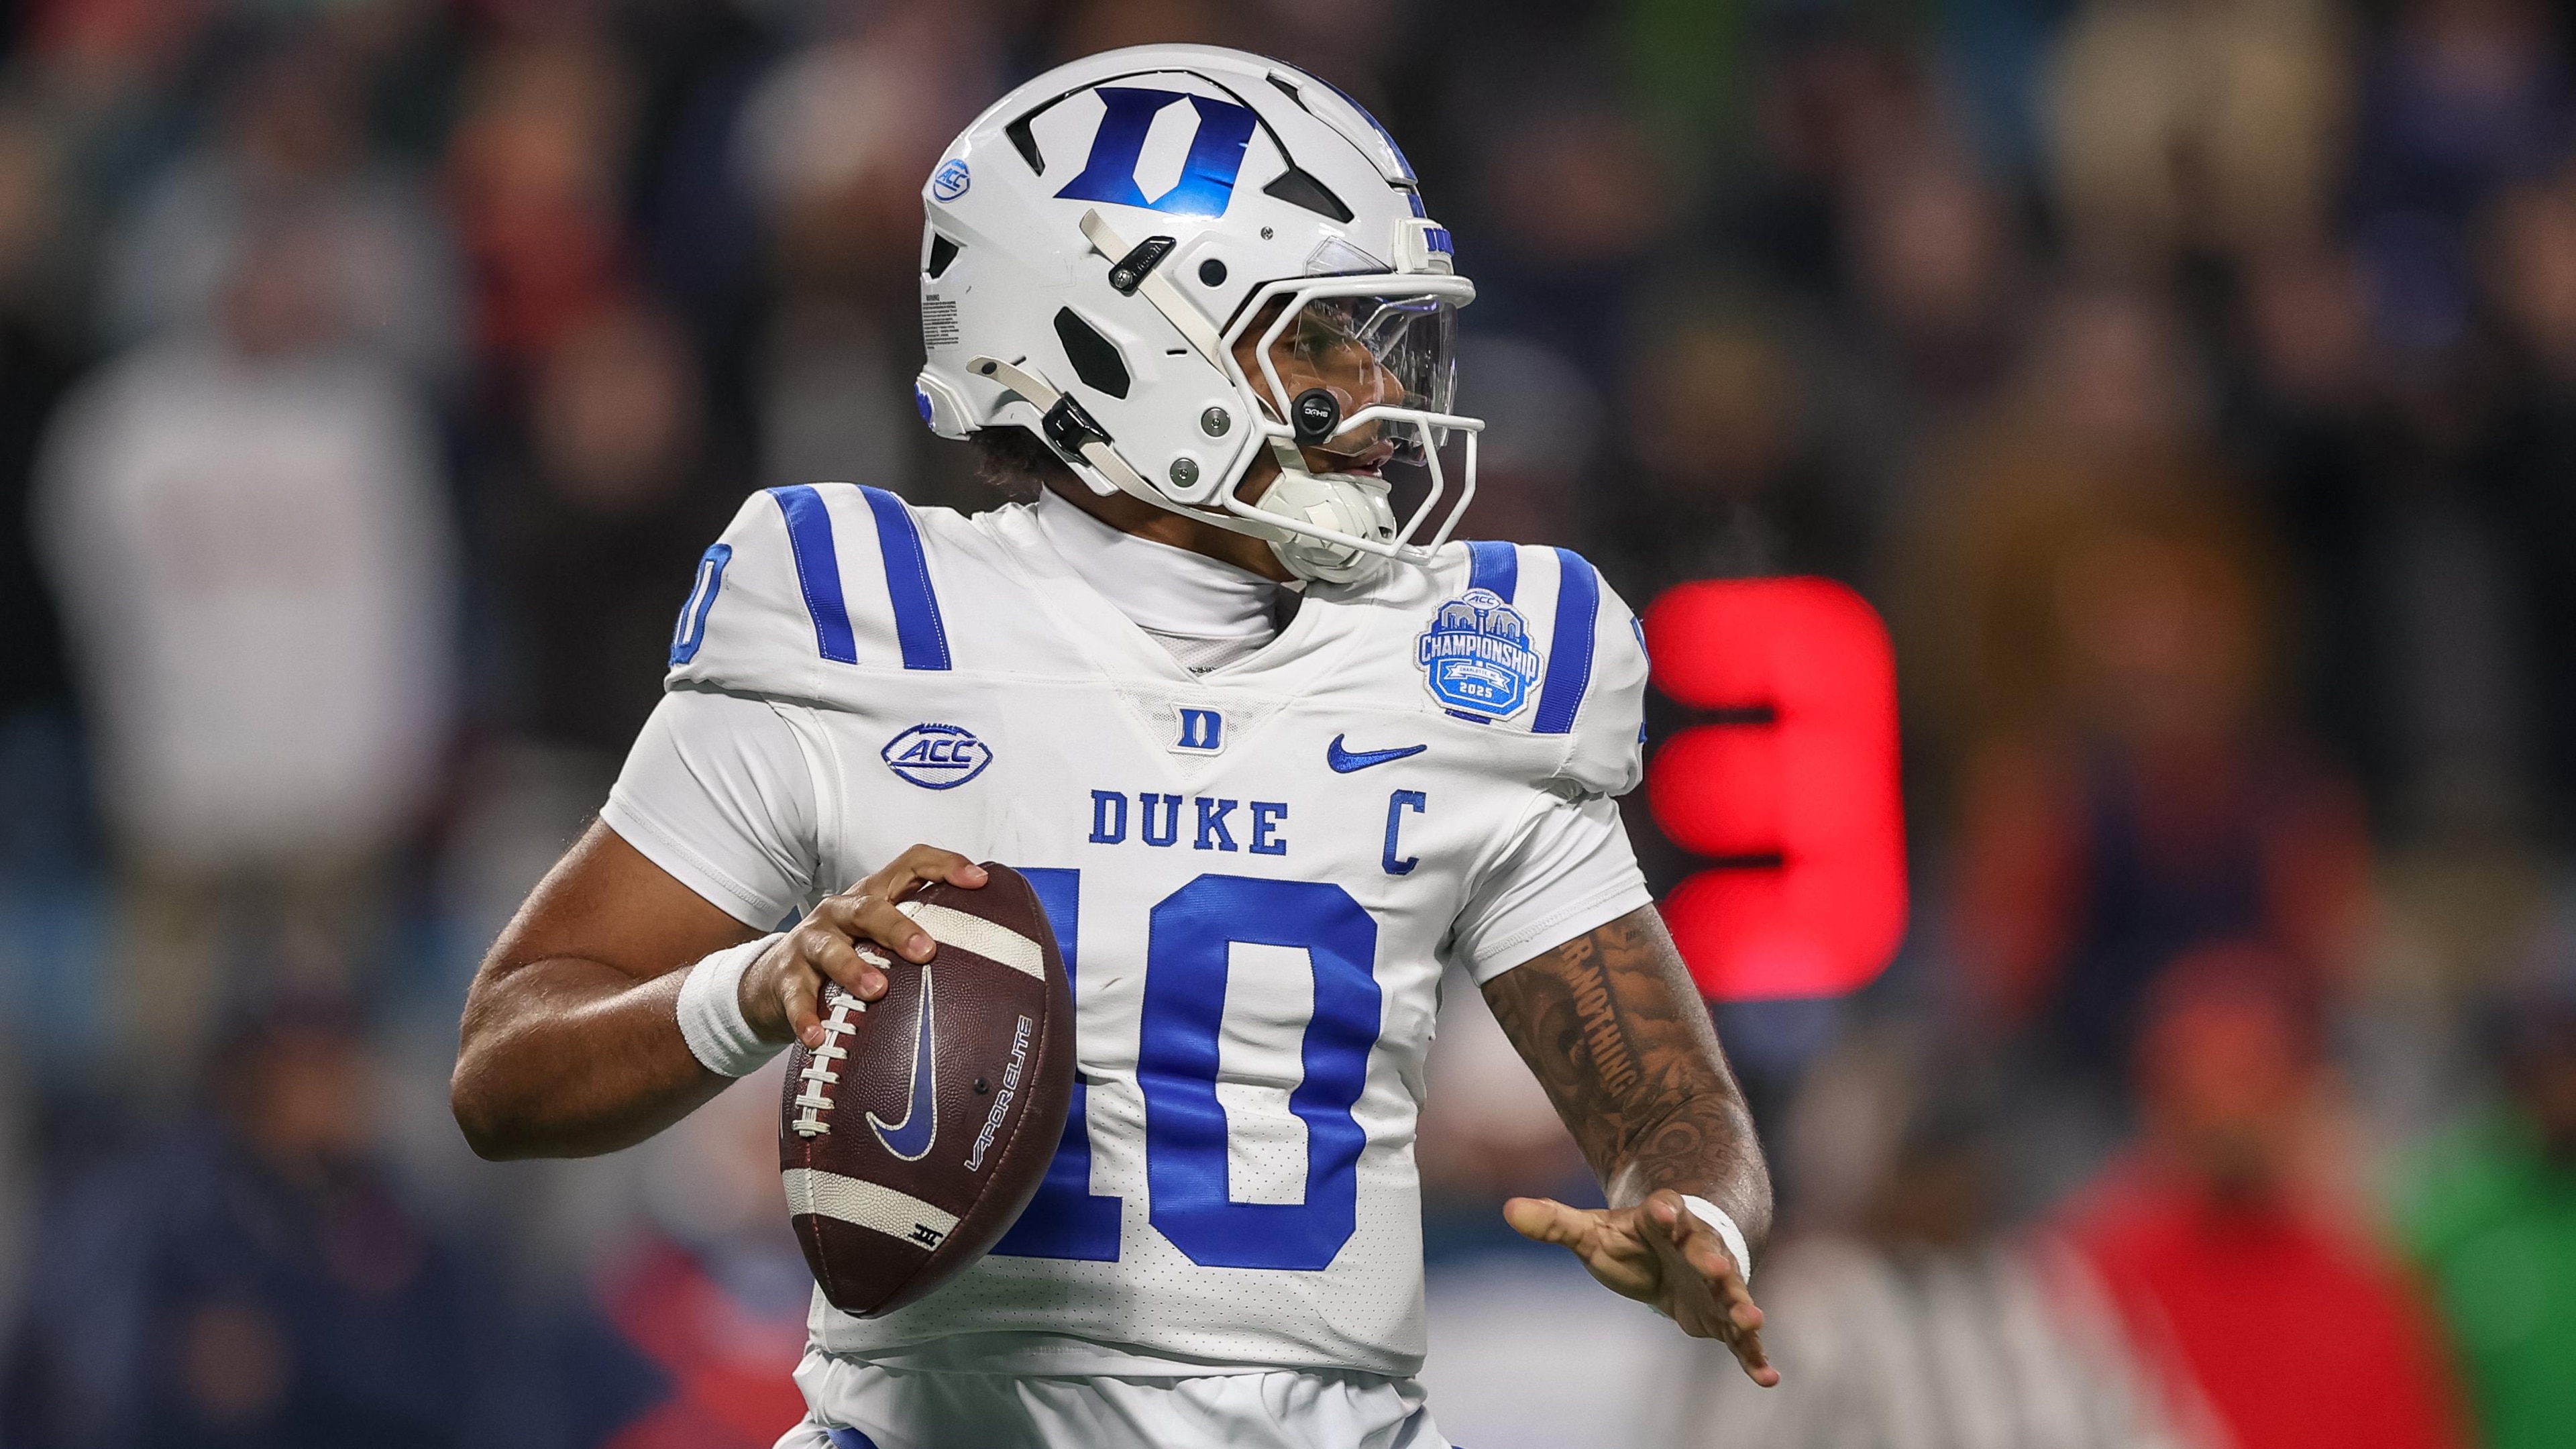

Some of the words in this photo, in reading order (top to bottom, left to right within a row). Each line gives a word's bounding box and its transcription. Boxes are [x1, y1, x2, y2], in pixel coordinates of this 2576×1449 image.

[1054, 87, 1256, 219] D
[938, 168, 967, 188] ACC
[1304, 408, 1328, 418] SHOC
[1468, 596, 1495, 605] ACC
[1421, 635, 1538, 683] CHAMPIONSHIP
[1459, 681, 1493, 698] 2025
[899, 739, 979, 763] ACC
[1178, 708, 1222, 749] D
[1644, 575, 1909, 1002] 3
[1089, 790, 1288, 856] DUKE
[1381, 789, 1426, 875] C
[1568, 966, 1638, 1098] NOTHING
[963, 1089, 1014, 1172] VAPOR
[1003, 1014, 1033, 1090] ELITE
